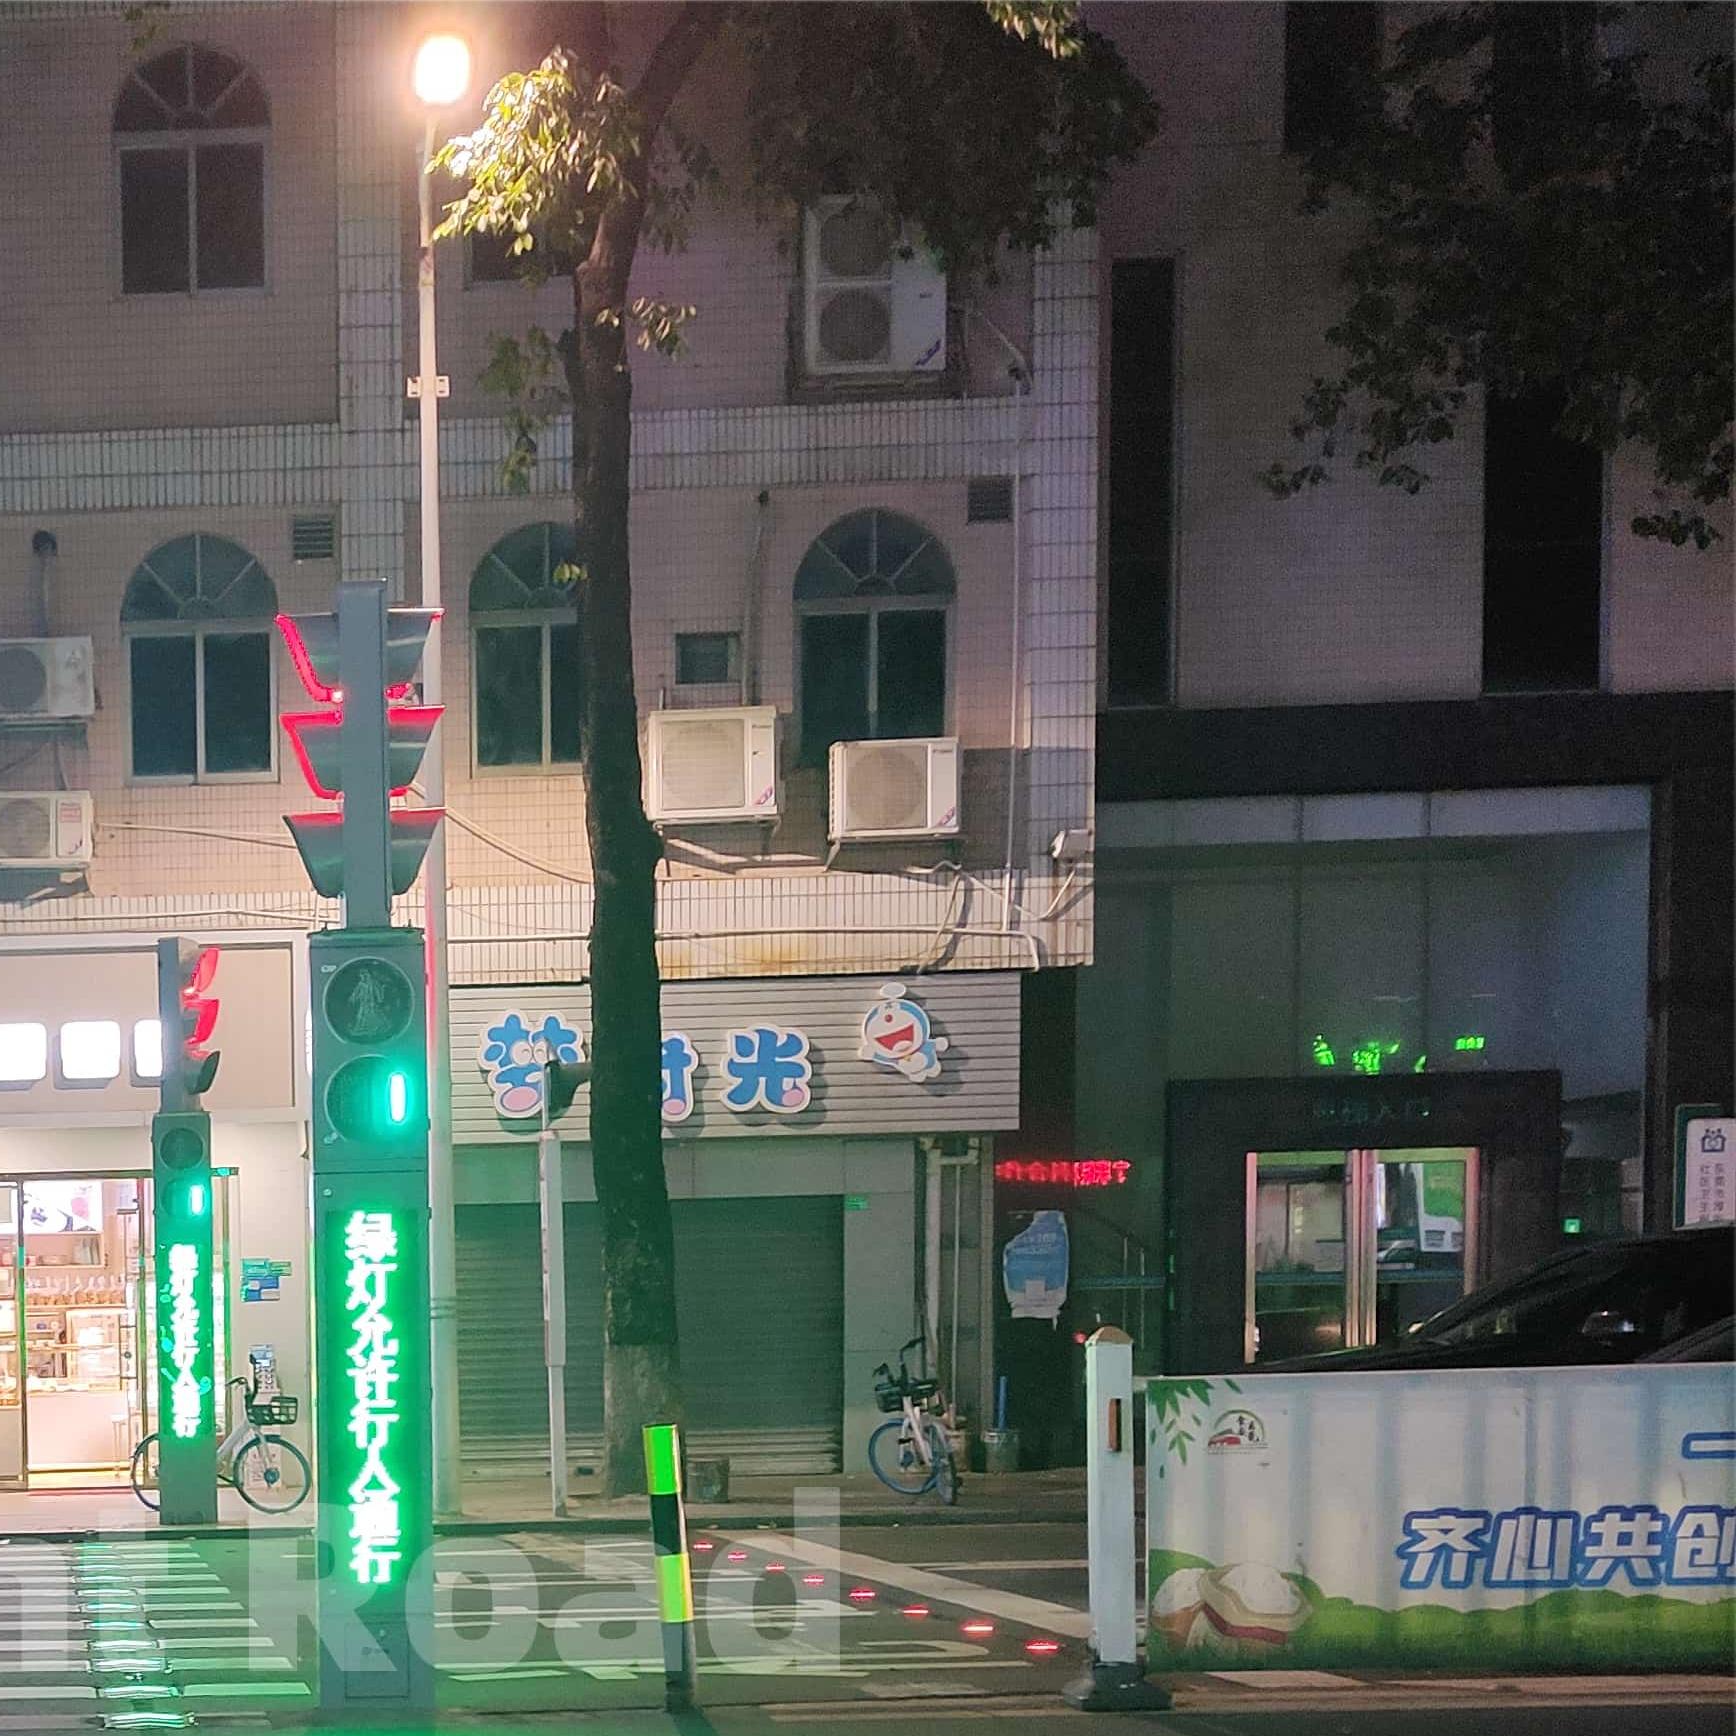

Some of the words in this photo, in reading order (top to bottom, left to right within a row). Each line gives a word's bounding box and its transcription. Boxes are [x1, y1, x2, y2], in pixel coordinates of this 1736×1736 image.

[344, 1210, 402, 1584] 绿灯允许行人通行
